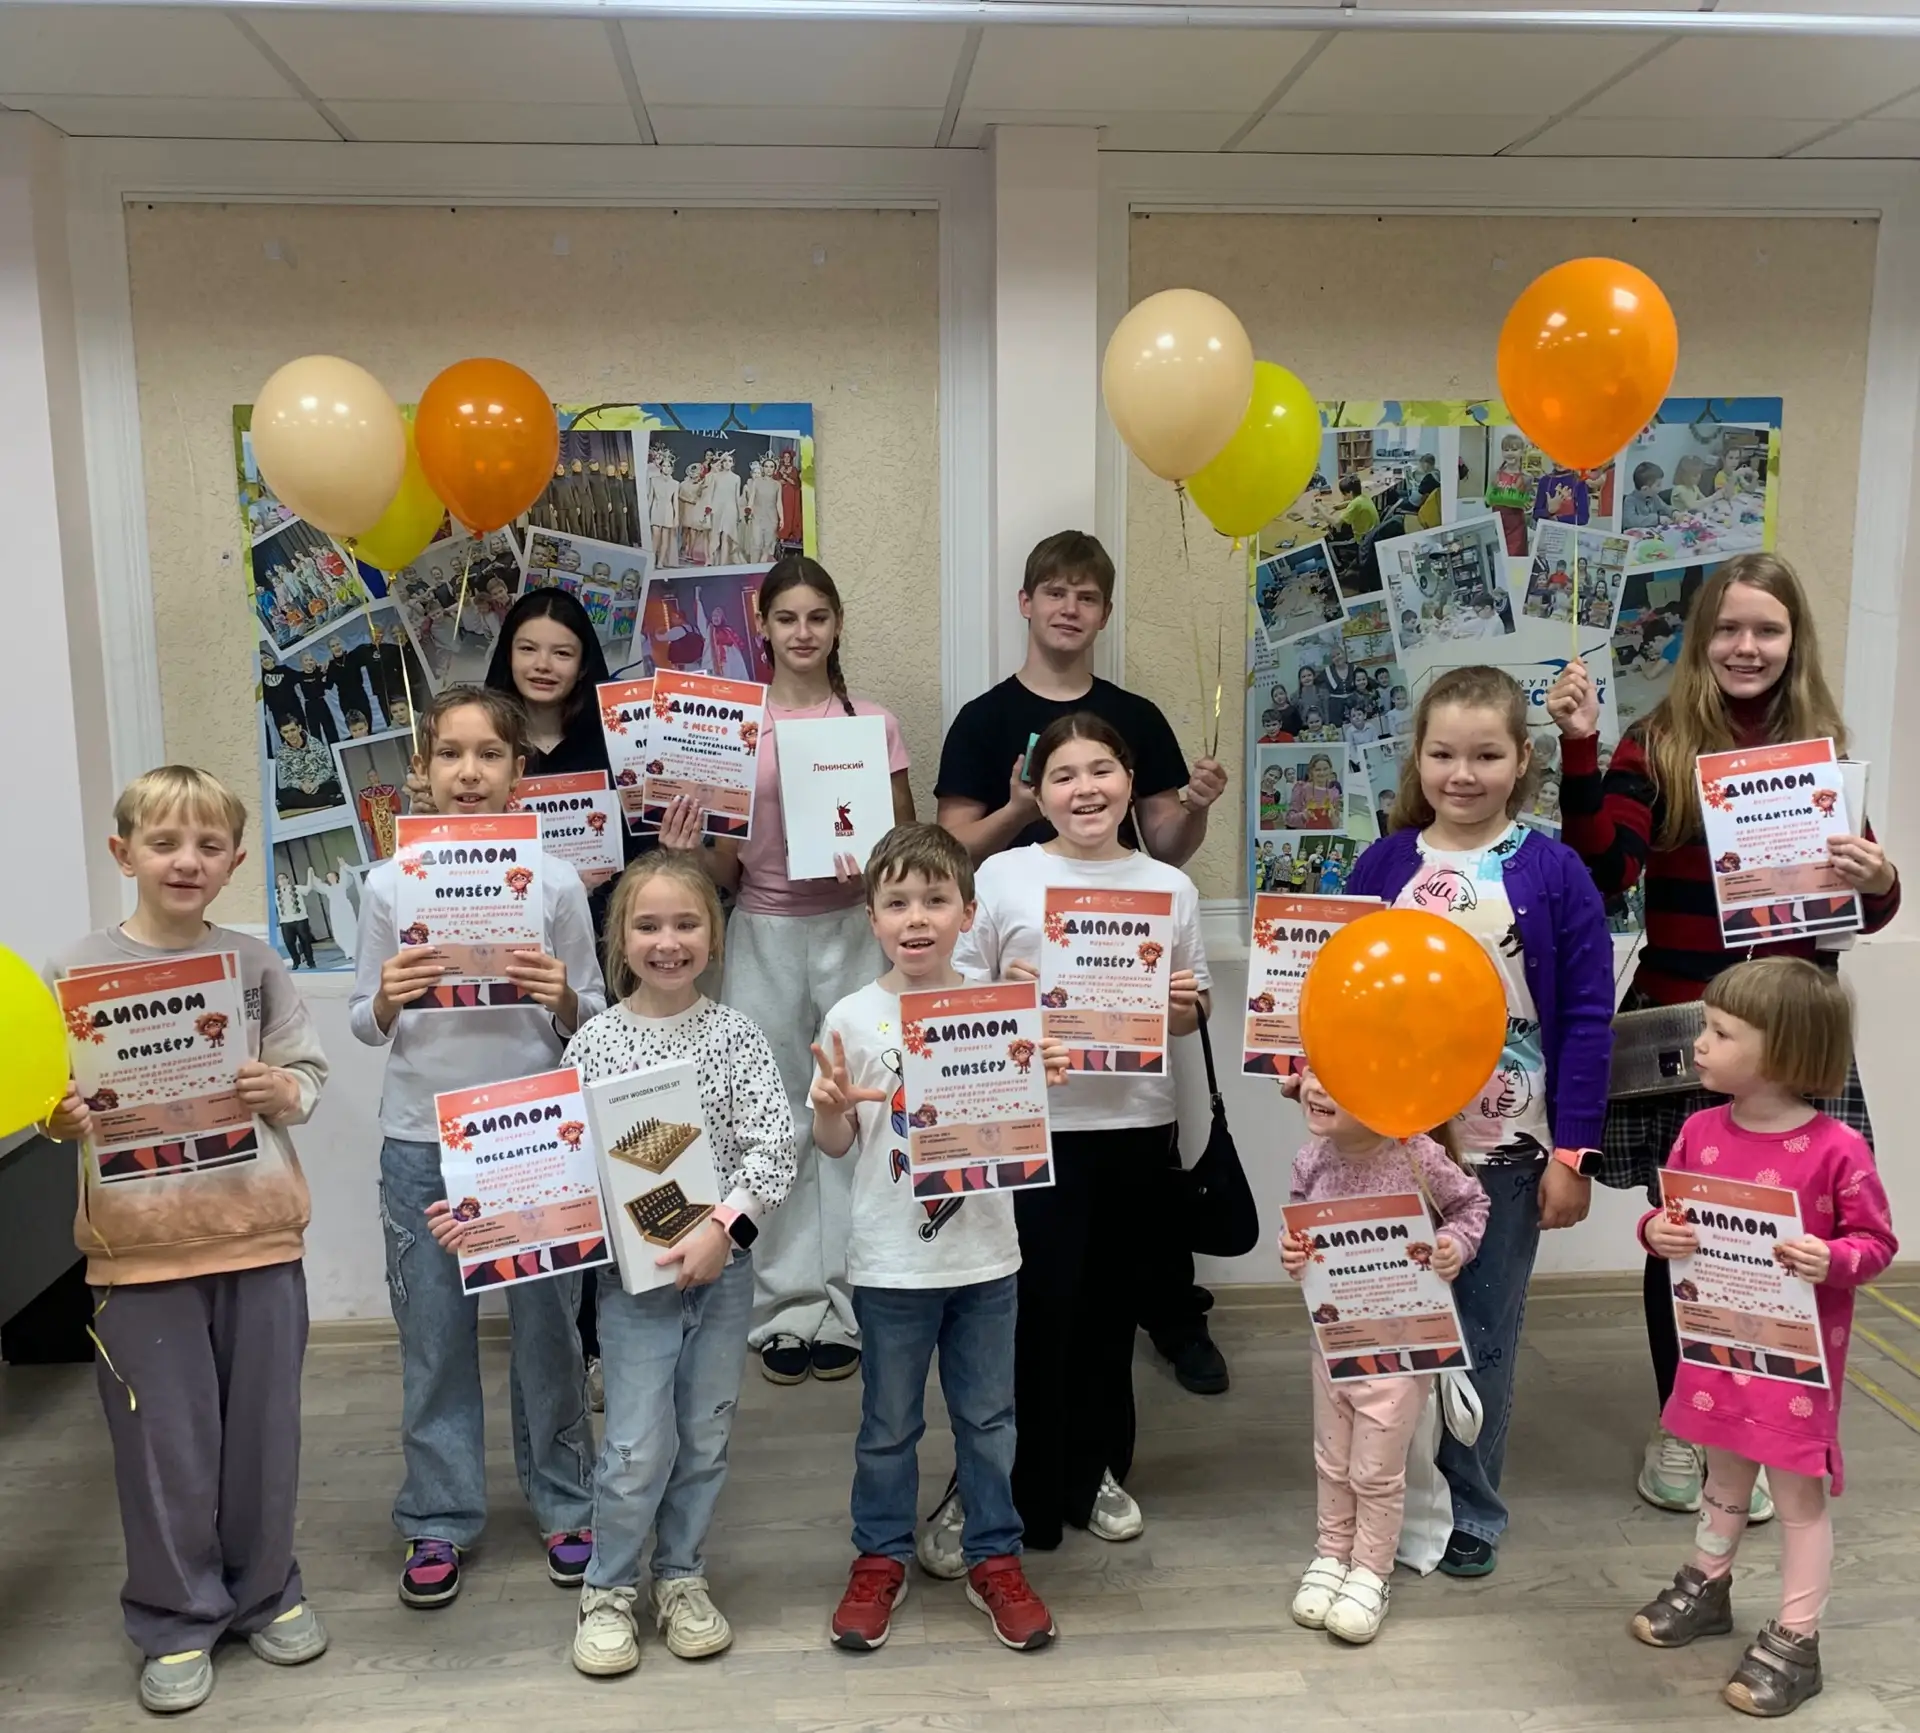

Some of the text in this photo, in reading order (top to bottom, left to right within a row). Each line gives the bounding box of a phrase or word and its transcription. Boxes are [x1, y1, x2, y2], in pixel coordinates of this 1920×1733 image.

[668, 699, 744, 722] ДИПЛОМ
[691, 722, 728, 735] МЕСТО
[813, 760, 864, 772] Ленинский
[1723, 771, 1815, 798] ДИПЛОМ
[1735, 806, 1813, 824] ПОБЕДИТЕЛЮ
[420, 847, 516, 865] ДИПЛОМ
[435, 883, 502, 898] ПРИЗЁРУ
[1063, 919, 1150, 936] ДИПЛОМ
[1273, 926, 1331, 944] ДИПЛ
[1076, 954, 1134, 968] ПРИЗЁРУ
[1266, 968, 1306, 977] КОМАНД
[90, 992, 206, 1028] ДИПЛОМ
[923, 1018, 1018, 1043] ДИПЛОМ
[116, 1033, 195, 1060] ПРИЗЁРУ
[940, 1057, 1006, 1077] ПРИЗЁРУ
[609, 1080, 681, 1104] LUXURY WOODEN CHESS SET
[461, 1103, 562, 1138] ДИПЛОМ
[475, 1140, 558, 1165] ПОБЕДИТЕЛЮ
[1684, 1206, 1778, 1238] ДИПЛОМ
[1310, 1223, 1409, 1249] ДИПЛОМ
[1695, 1245, 1774, 1268] ПОБЕДИТЕЛЮ
[1327, 1259, 1409, 1276] ПОБЕДИТЕЛЮ
